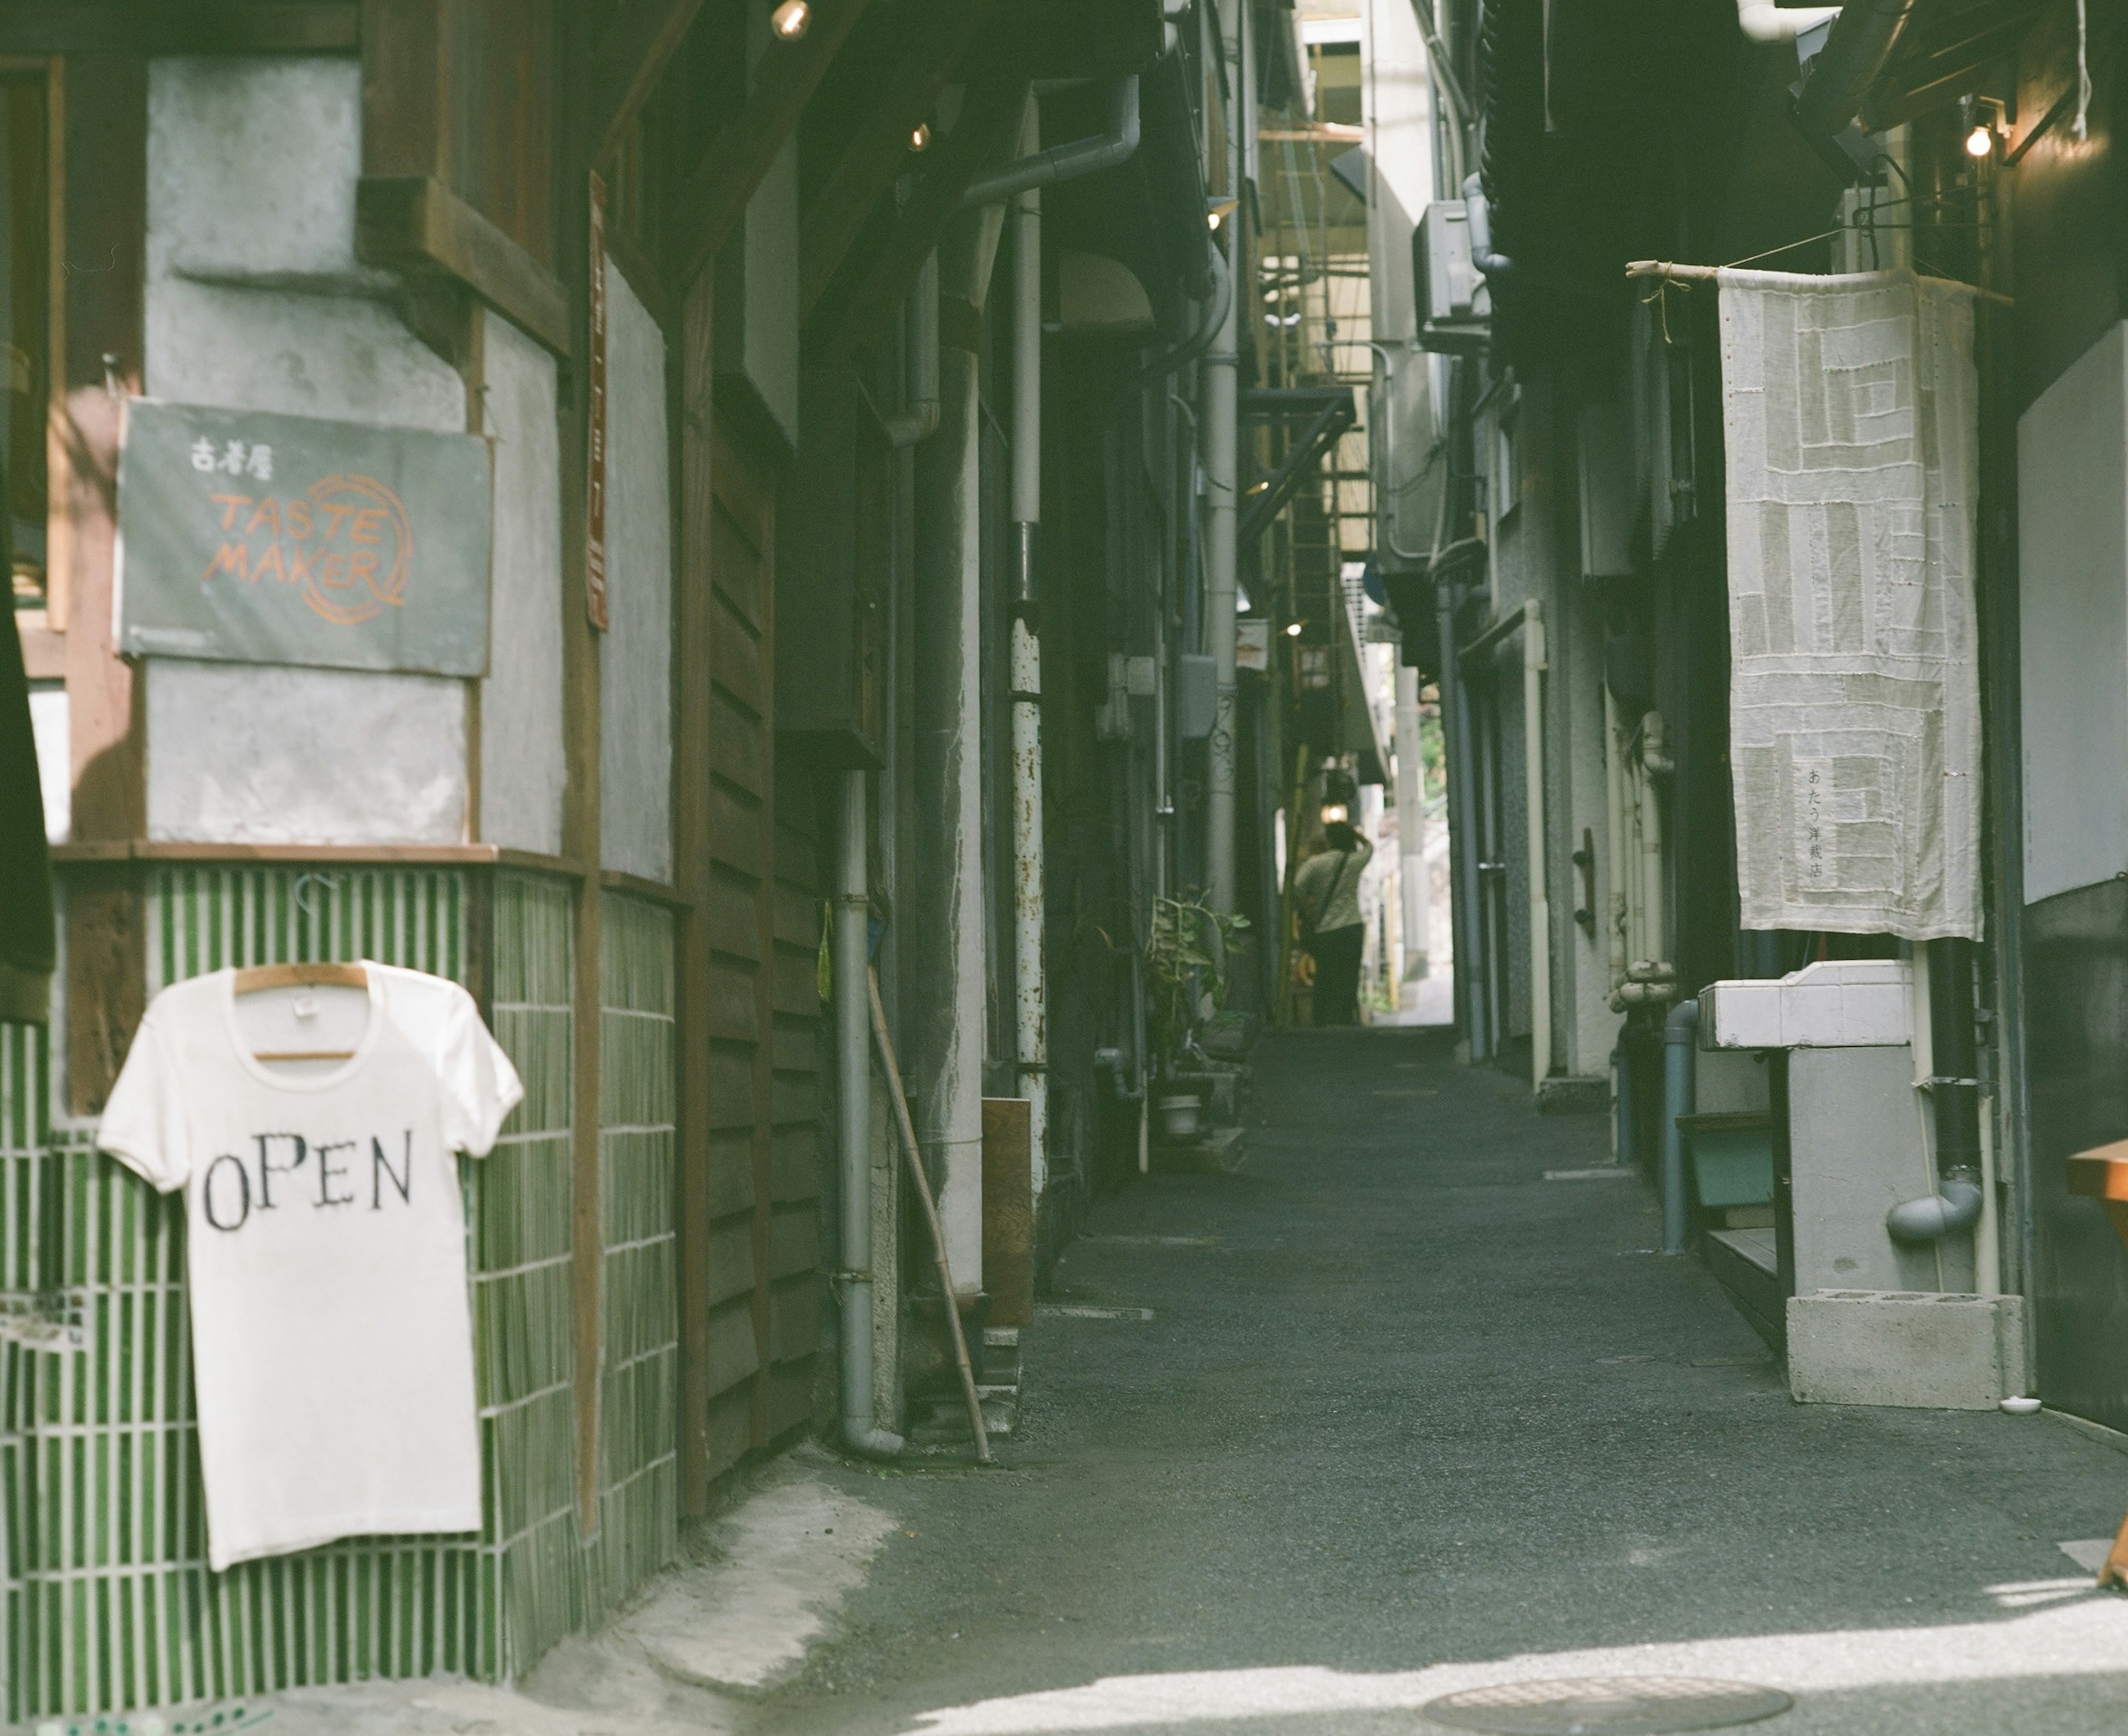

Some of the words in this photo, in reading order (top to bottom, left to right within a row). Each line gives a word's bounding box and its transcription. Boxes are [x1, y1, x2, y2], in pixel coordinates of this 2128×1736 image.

[209, 493, 390, 545] TASTE
[203, 542, 406, 606] MAKER
[1808, 769, 1823, 878] あたう洋裁店
[202, 1129, 413, 1233] OPEN
